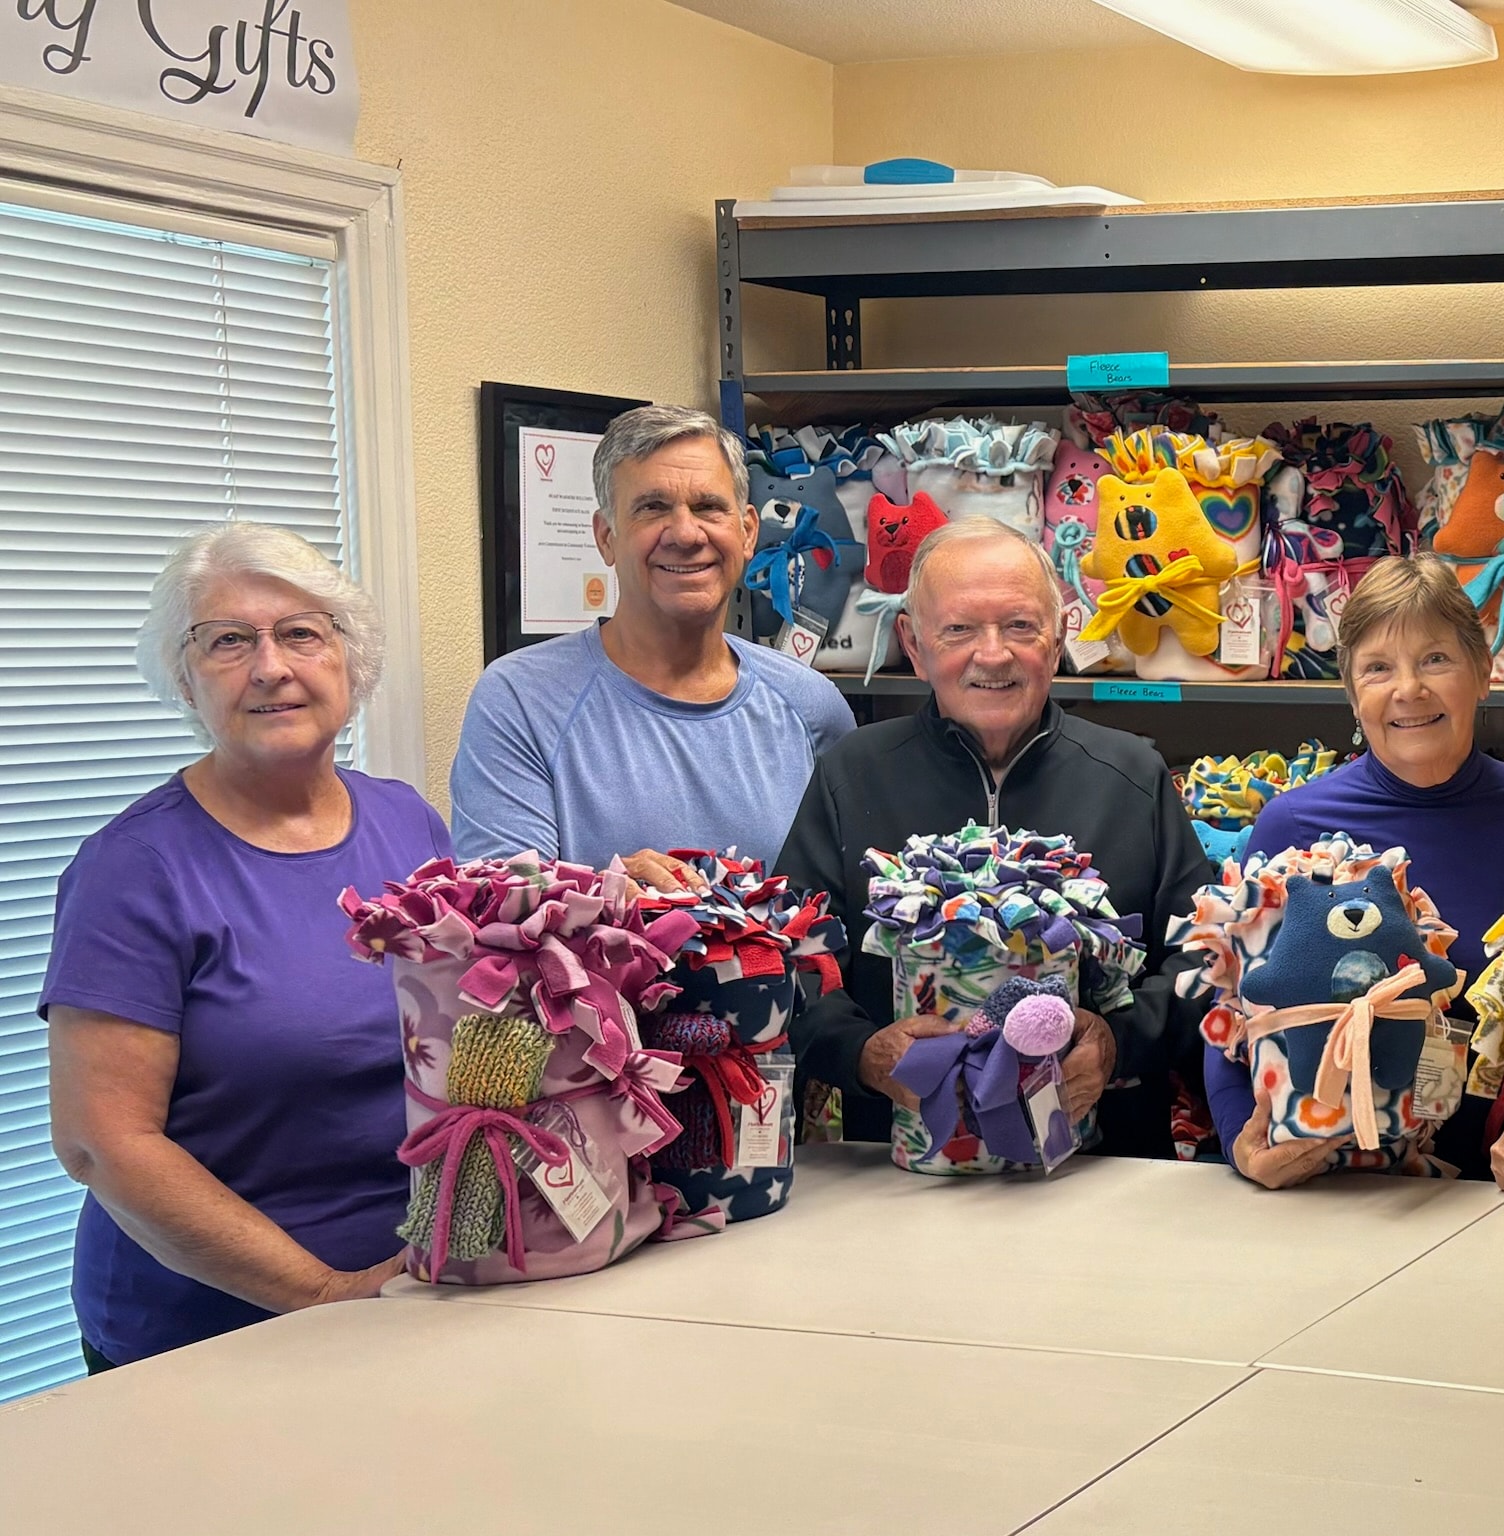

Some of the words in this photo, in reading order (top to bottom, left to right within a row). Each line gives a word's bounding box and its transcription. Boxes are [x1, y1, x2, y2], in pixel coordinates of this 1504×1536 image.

[137, 0, 336, 118] Gifts
[1089, 360, 1121, 373] Fleece
[1106, 374, 1133, 384] Bears
[1109, 685, 1137, 696] Fleece
[1142, 687, 1165, 698] Bears
